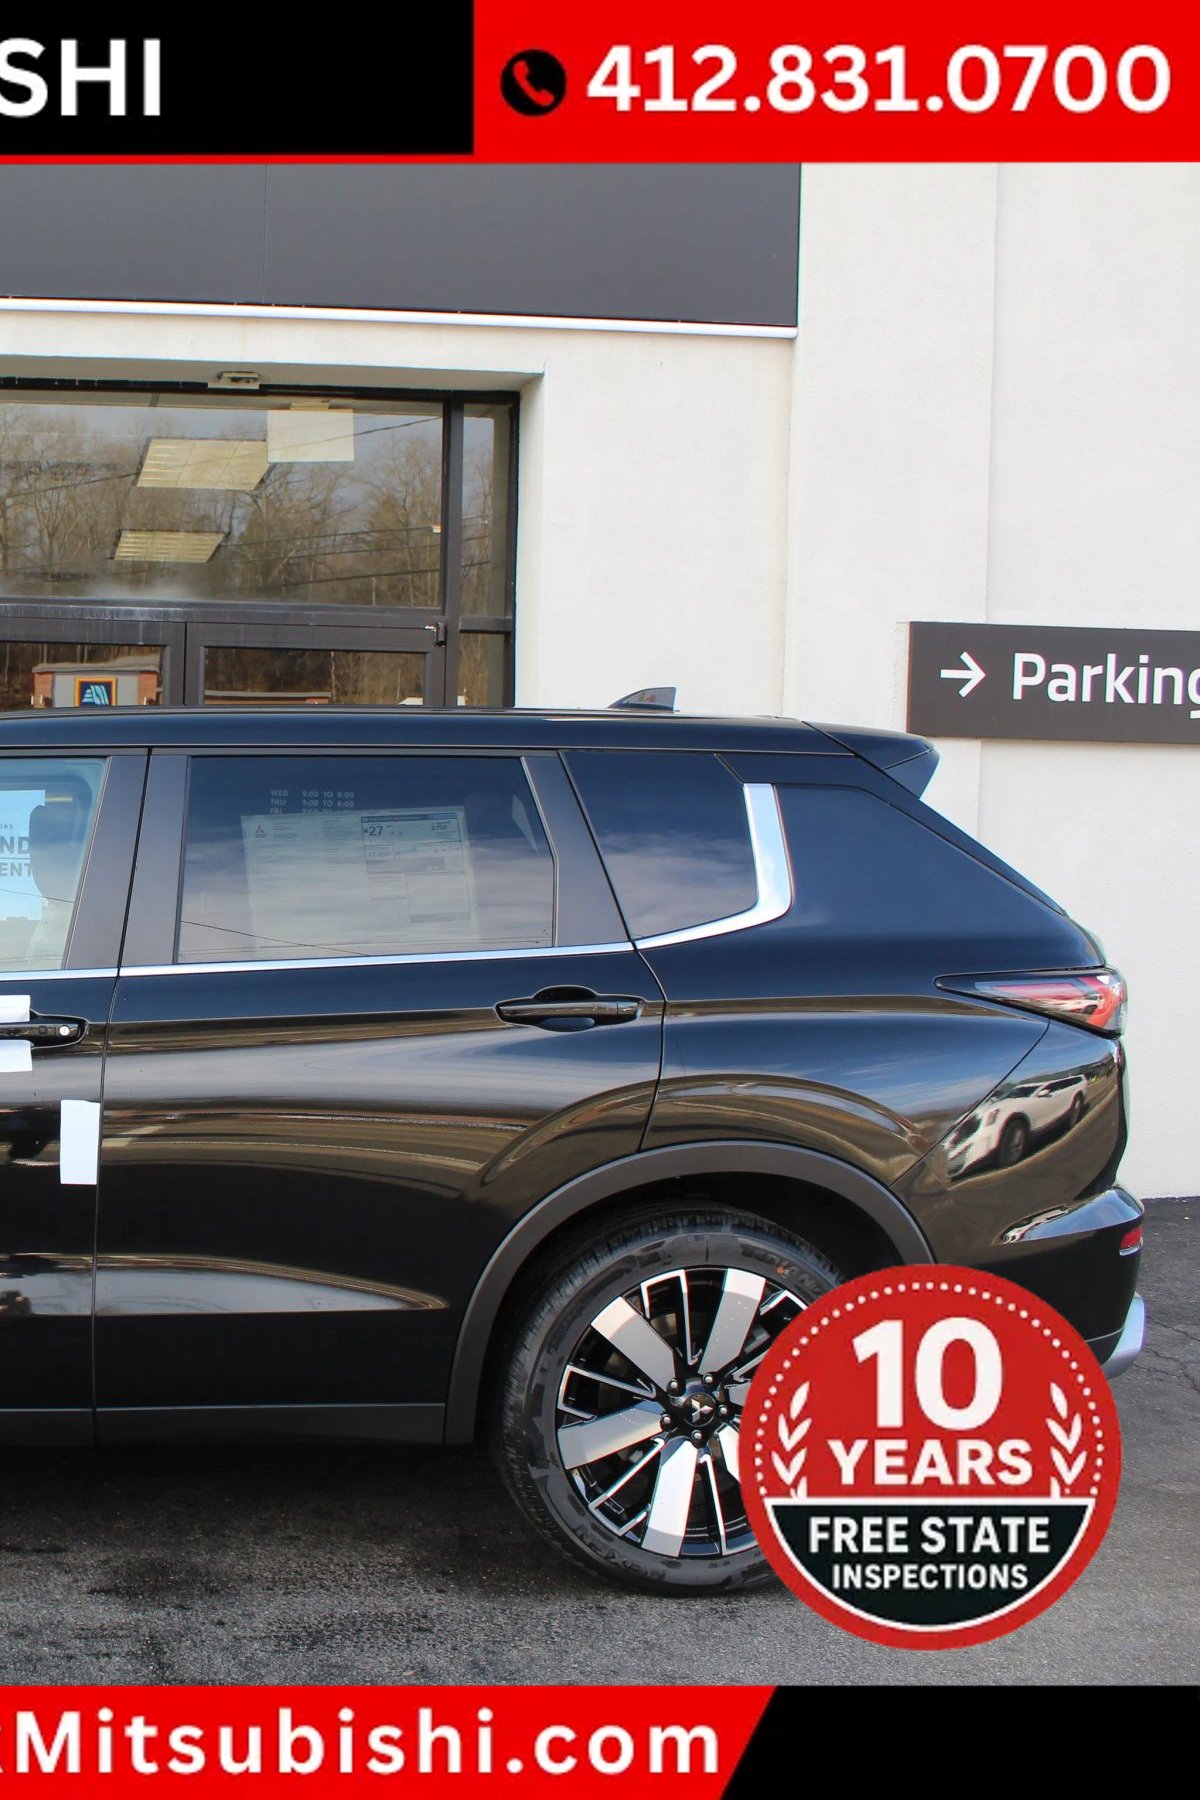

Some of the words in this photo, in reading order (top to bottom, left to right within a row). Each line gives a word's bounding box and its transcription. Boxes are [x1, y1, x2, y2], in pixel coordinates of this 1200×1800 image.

[271, 789, 289, 797] WED
[271, 798, 286, 806] THU
[368, 825, 384, 836] 27
